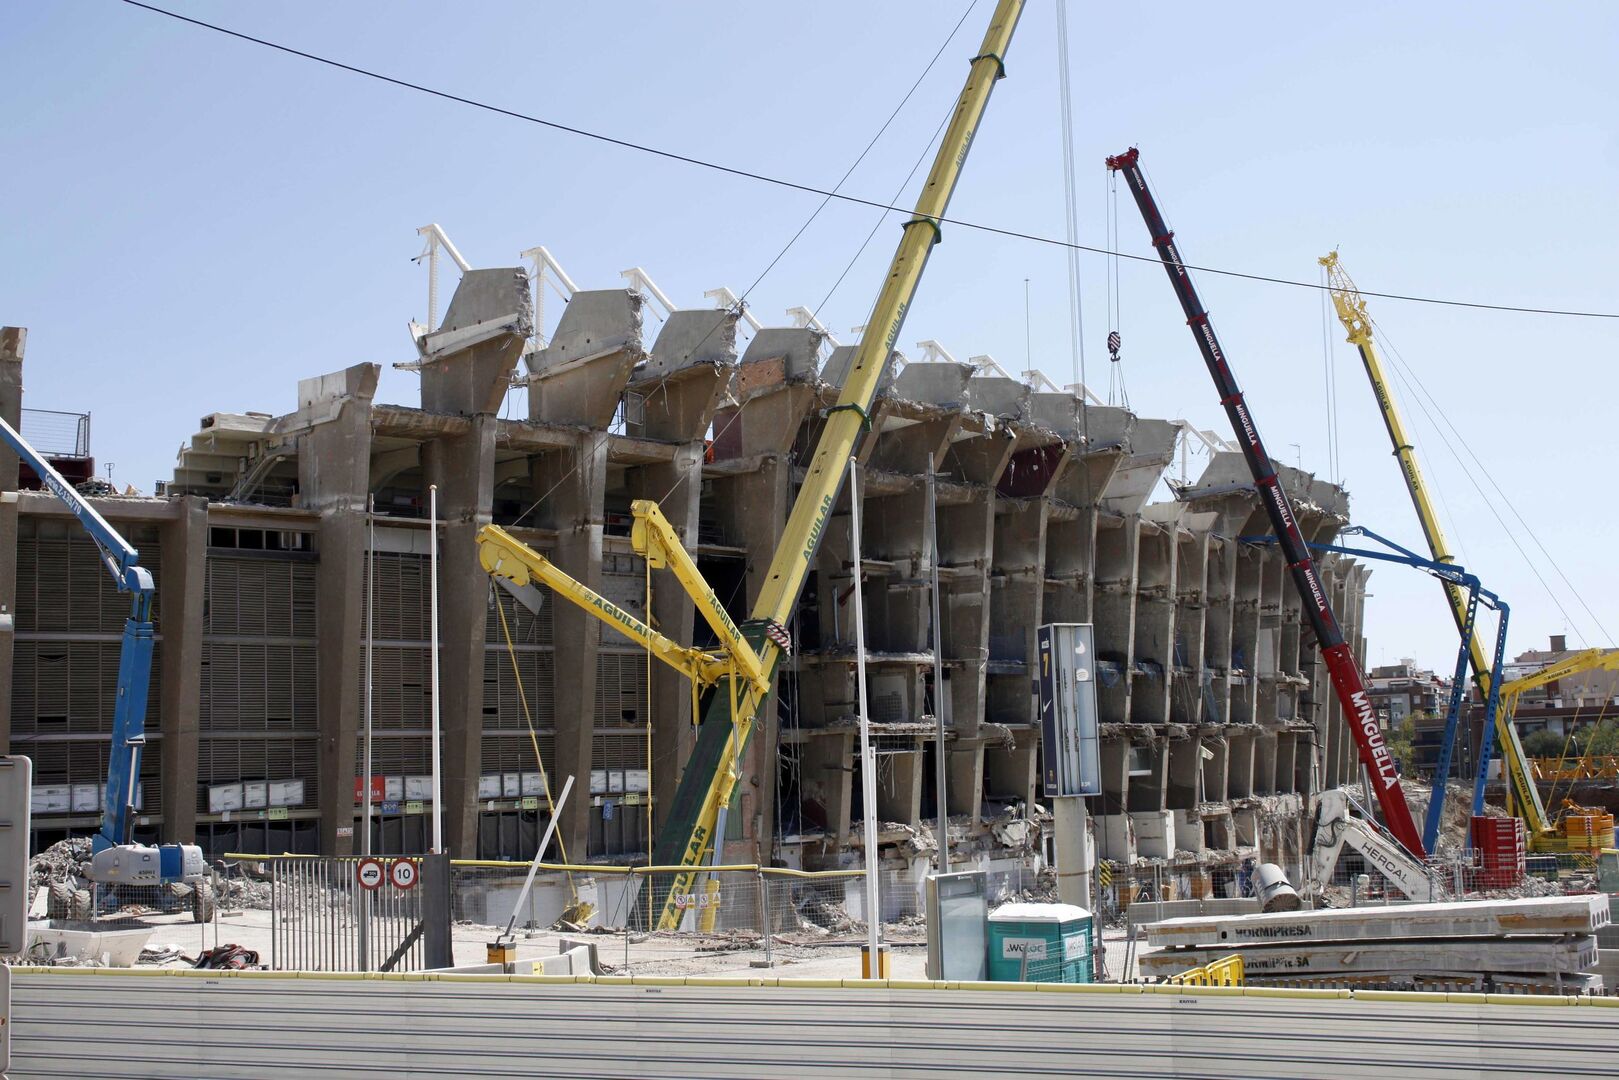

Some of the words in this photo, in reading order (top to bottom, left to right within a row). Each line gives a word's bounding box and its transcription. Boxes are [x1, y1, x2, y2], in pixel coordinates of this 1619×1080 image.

[955, 130, 972, 168] AGUILAR
[885, 302, 906, 350] AGUILAR
[1201, 323, 1221, 361] MINGUELLA
[1376, 381, 1390, 410] AGUILAR
[1236, 403, 1257, 446] MINGUELLA
[1405, 460, 1419, 491] AGUILAR
[1270, 485, 1292, 528] MINGUELLA
[803, 494, 833, 561] AGUILAR
[1304, 568, 1326, 612] MINGUELLA
[709, 597, 742, 644] AGUILAR
[1042, 652, 1049, 678] 7
[1547, 668, 1572, 680] AGUILAR
[1350, 690, 1397, 791] MINGUELLA
[1516, 772, 1532, 806] AGUILAR
[397, 868, 411, 880] 10
[1361, 842, 1408, 885] HERCAL
